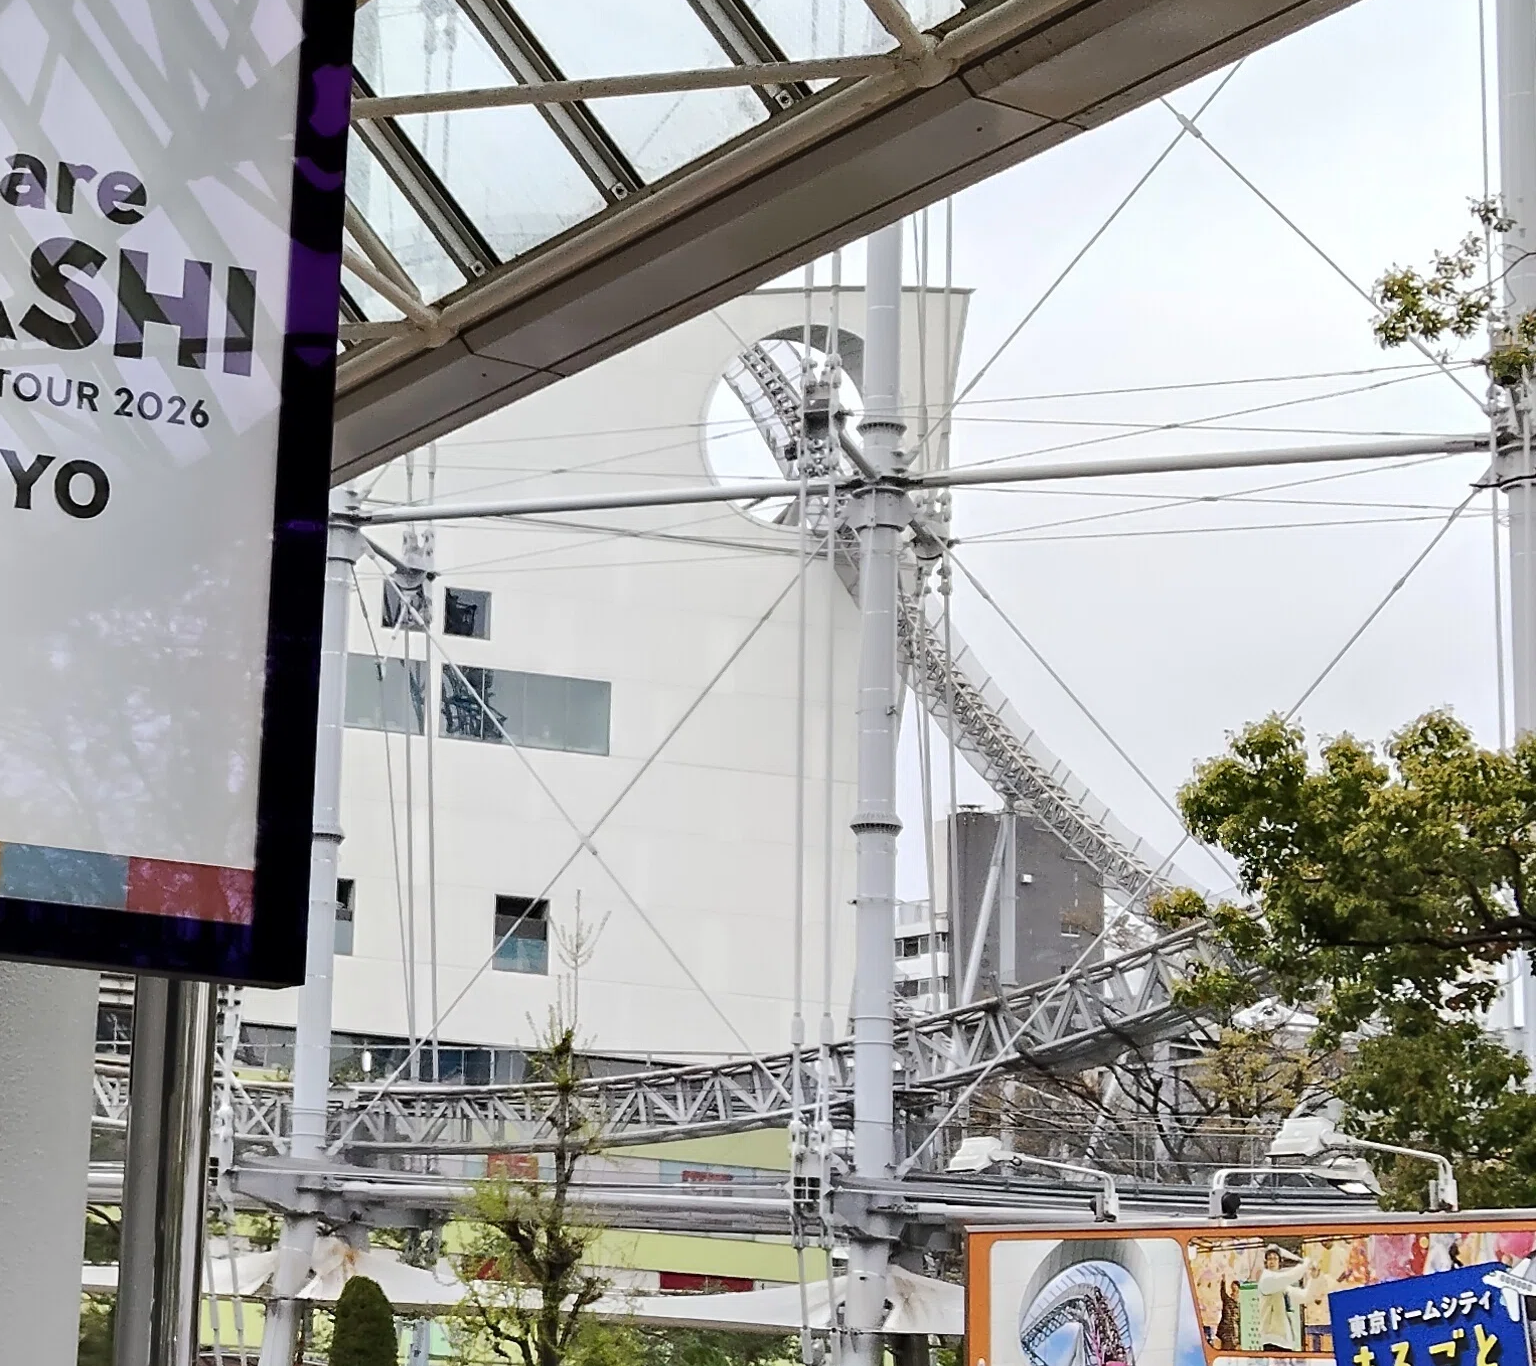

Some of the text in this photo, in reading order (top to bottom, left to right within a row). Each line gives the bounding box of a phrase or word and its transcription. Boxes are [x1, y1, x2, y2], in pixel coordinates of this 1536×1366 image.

[0, 153, 148, 226] are
[113, 390, 210, 429] 2026
[1348, 1290, 1492, 1339] 東京ドームシティ
